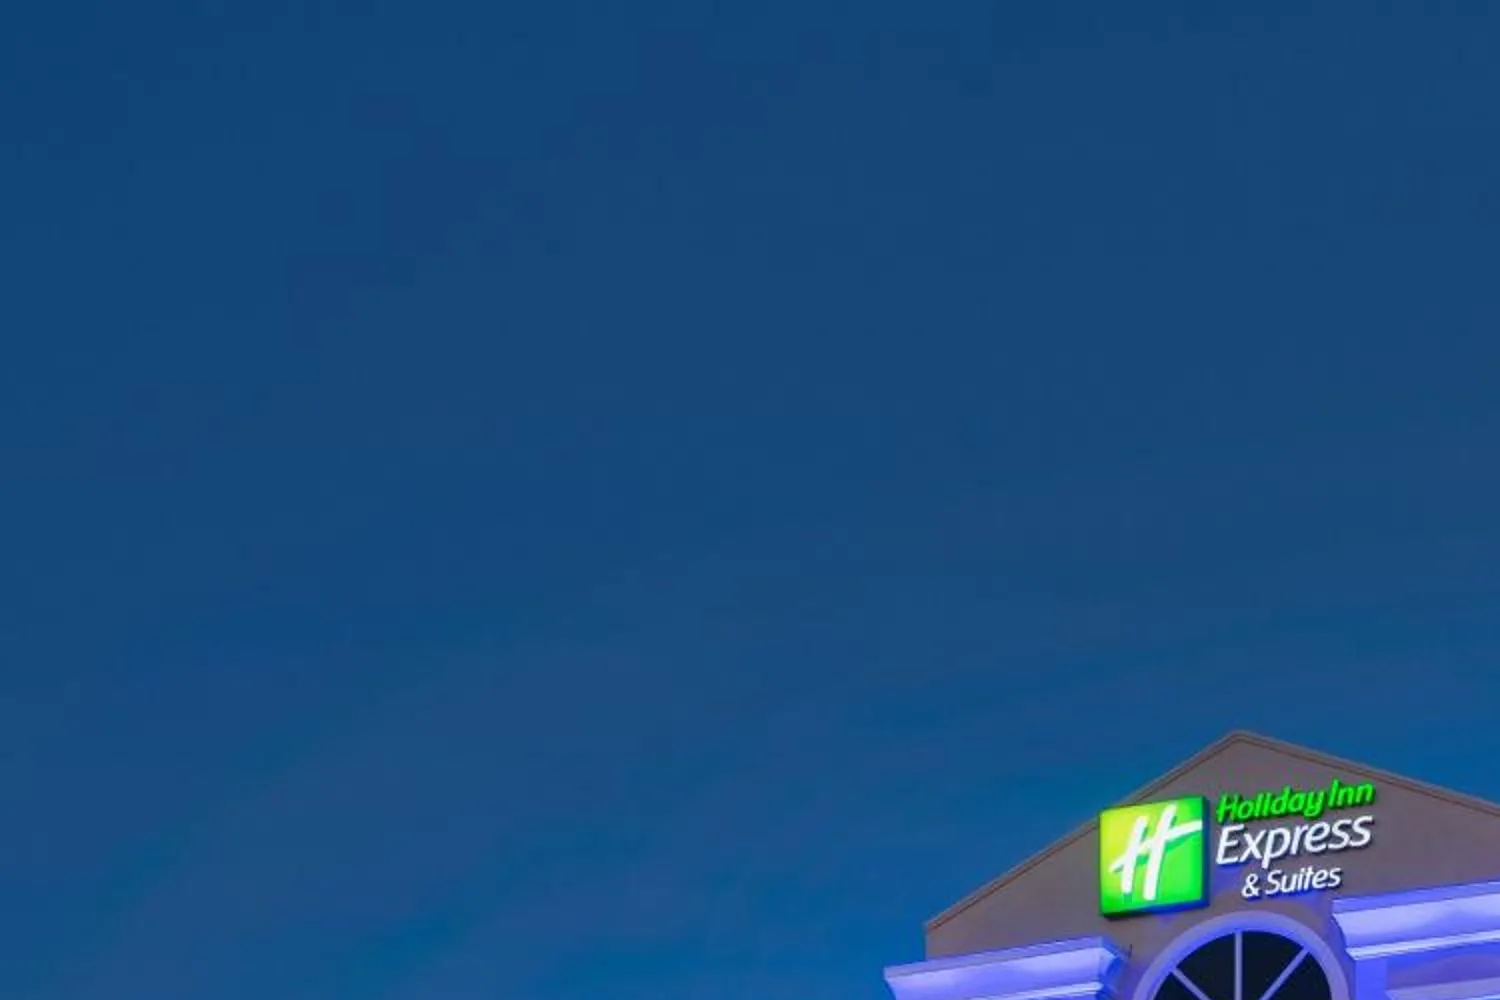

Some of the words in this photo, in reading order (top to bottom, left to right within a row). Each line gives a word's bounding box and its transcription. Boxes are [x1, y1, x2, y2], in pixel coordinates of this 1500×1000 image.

[1216, 786, 1325, 822] Holiday
[1330, 779, 1375, 807] Inn
[1110, 804, 1202, 900] H
[1216, 815, 1373, 868] Express
[1241, 873, 1259, 898] &
[1265, 867, 1341, 894] Suites
